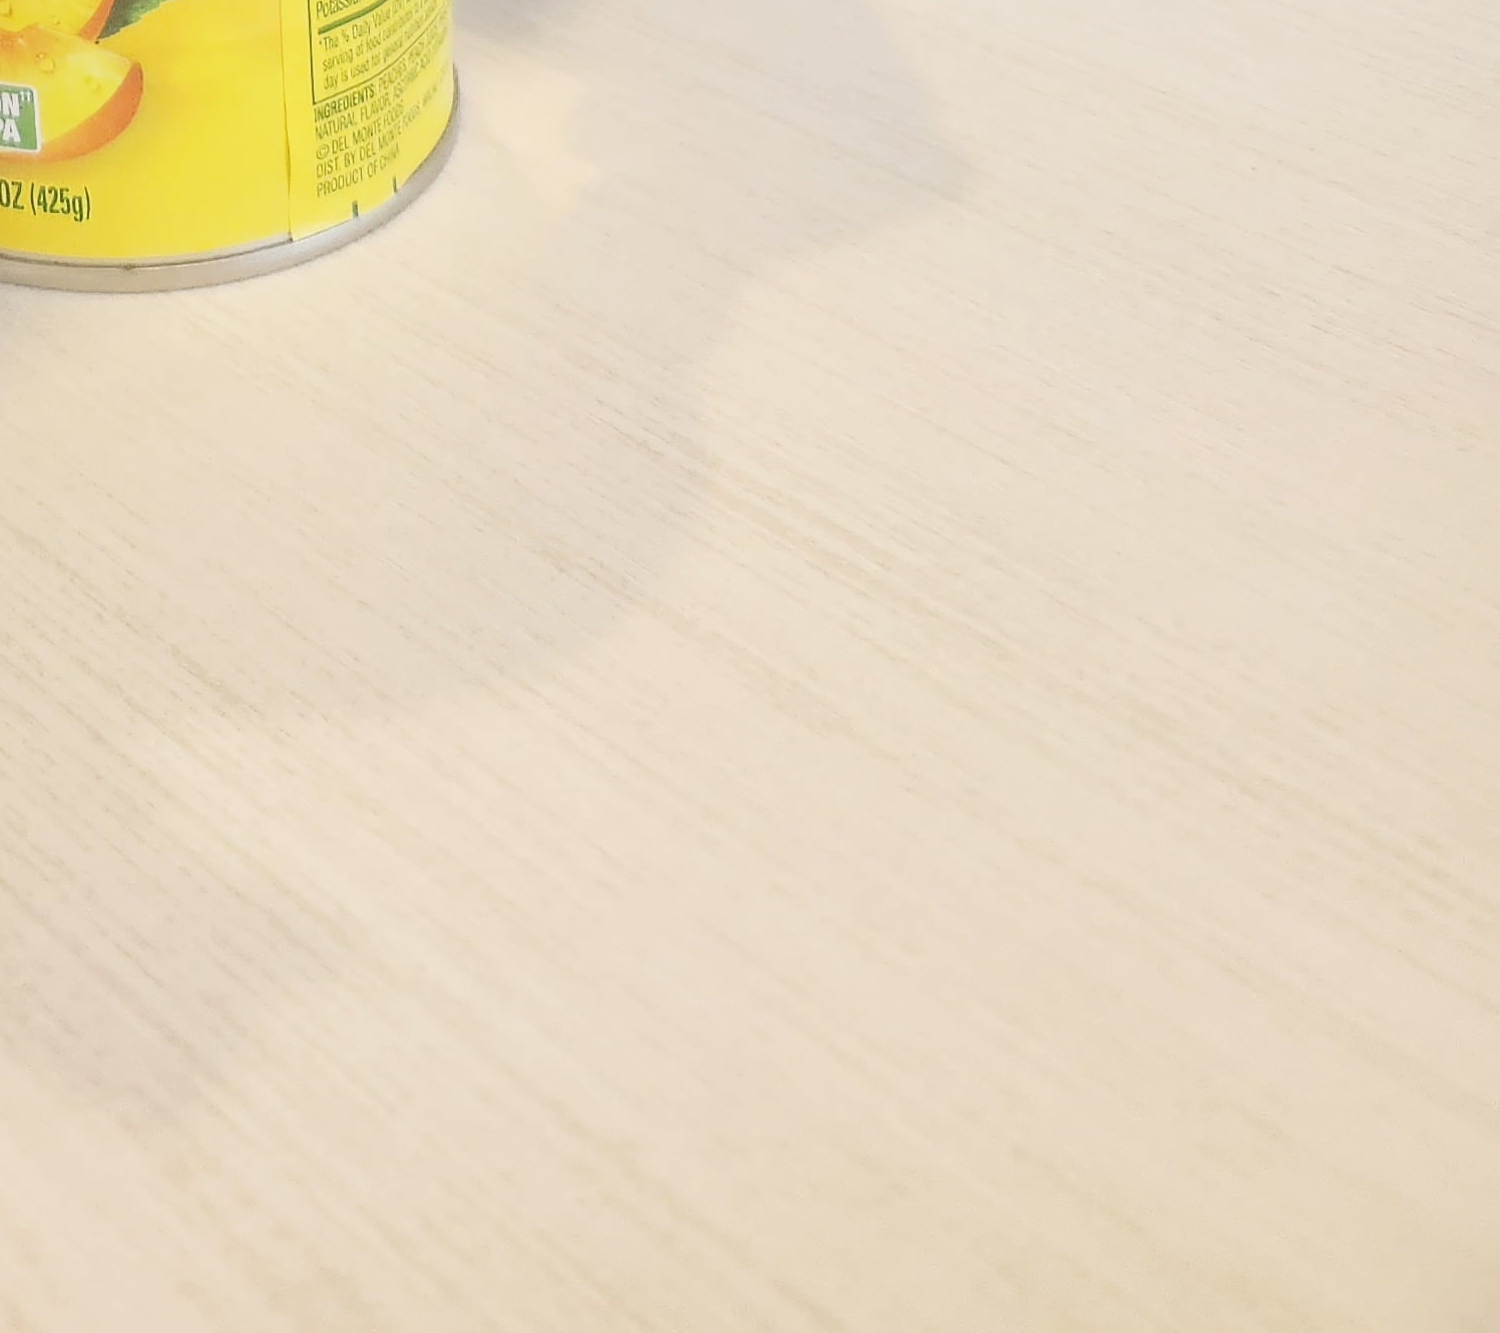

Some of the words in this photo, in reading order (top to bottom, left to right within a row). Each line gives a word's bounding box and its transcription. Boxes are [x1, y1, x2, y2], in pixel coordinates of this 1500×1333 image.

[352, 21, 371, 40] Daily
[322, 48, 353, 72] serving
[324, 76, 339, 90] day
[315, 111, 358, 140] NATURAL
[332, 135, 349, 154] DEL
[352, 117, 381, 145] MONTE
[344, 150, 356, 168] BY
[359, 141, 376, 161] DEL
[317, 166, 364, 197] PRODUCT
[367, 160, 379, 178] OF
[30, 182, 91, 222] (425g)
